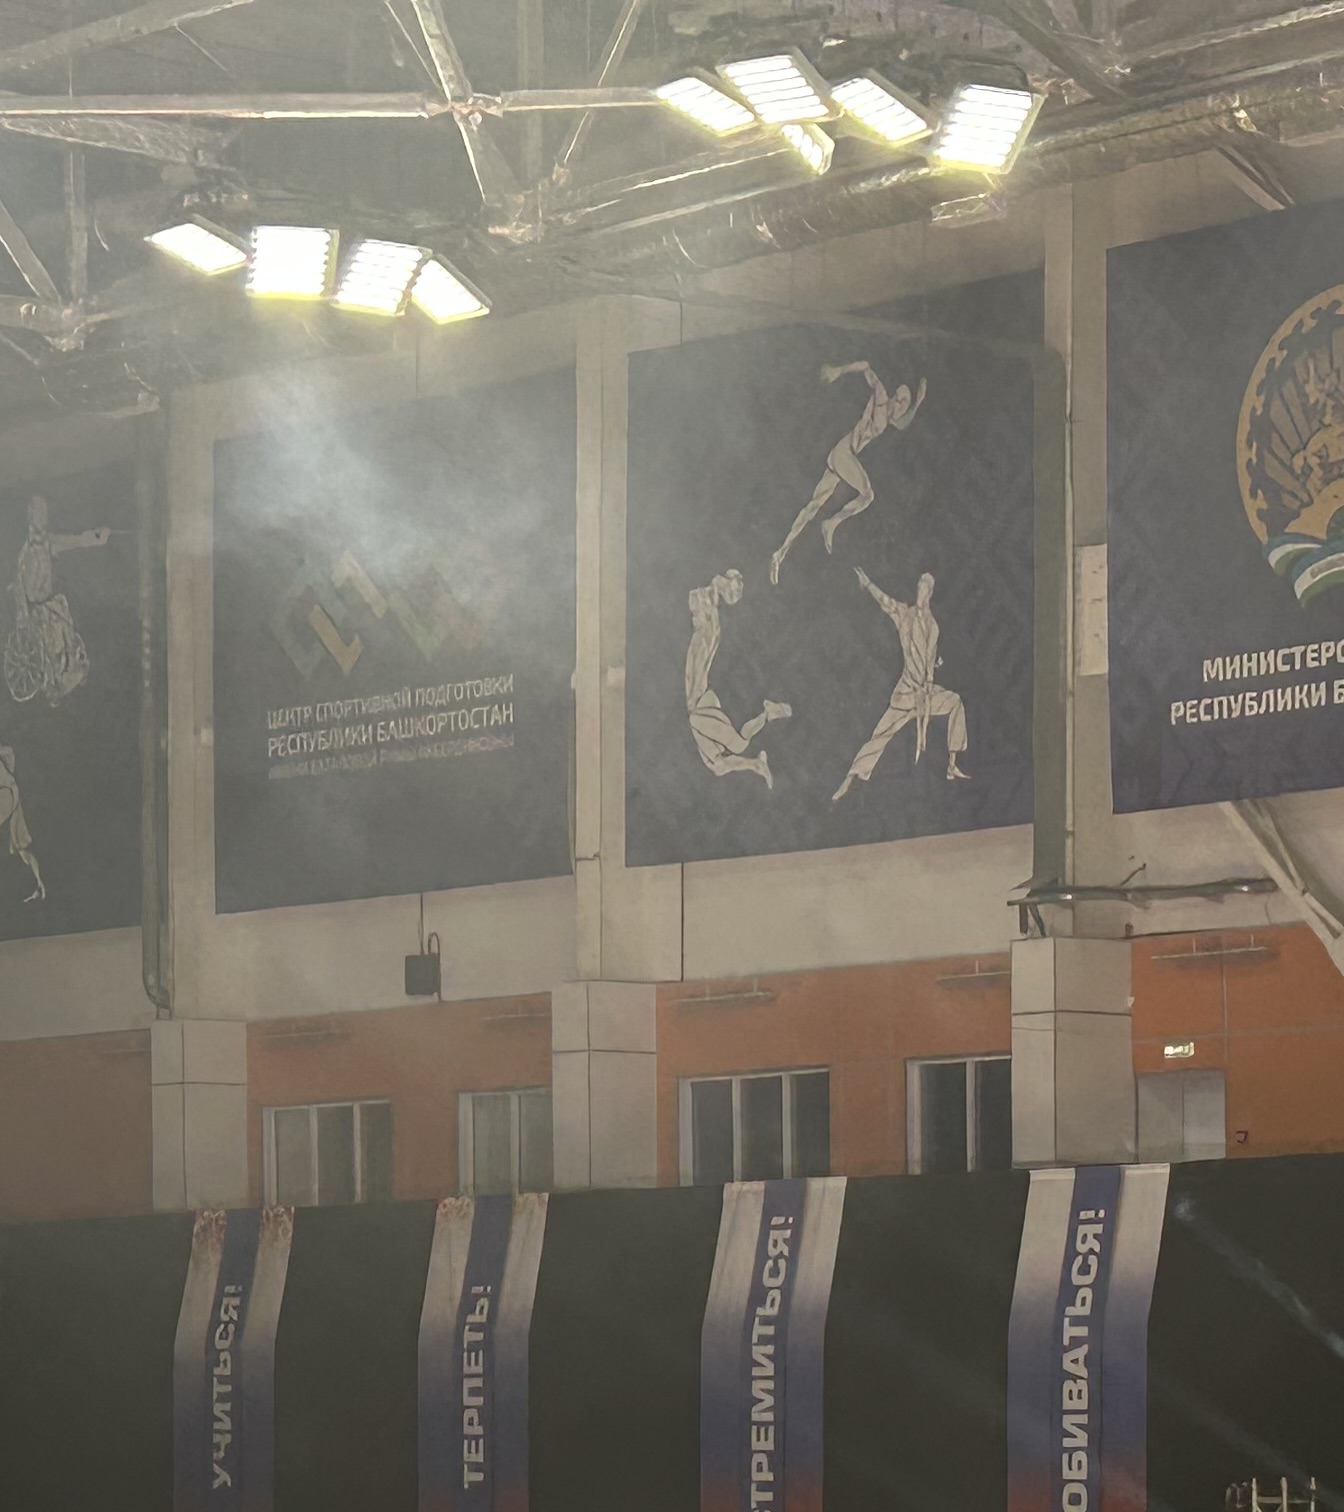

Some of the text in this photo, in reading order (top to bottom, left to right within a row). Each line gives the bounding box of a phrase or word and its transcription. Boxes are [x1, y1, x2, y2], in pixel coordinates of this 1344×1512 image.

[414, 673, 514, 707] ПОДГОТОВКИ
[1170, 680, 1327, 726] РЕСПУБЛИКИ
[267, 722, 373, 758] РЕСПУБЛИКИ
[376, 702, 514, 743] БАШКОРТОСТАН
[211, 1284, 244, 1489] УЧИТЬСЯ!
[461, 1283, 492, 1490] ТЕРПЕТЬ!
